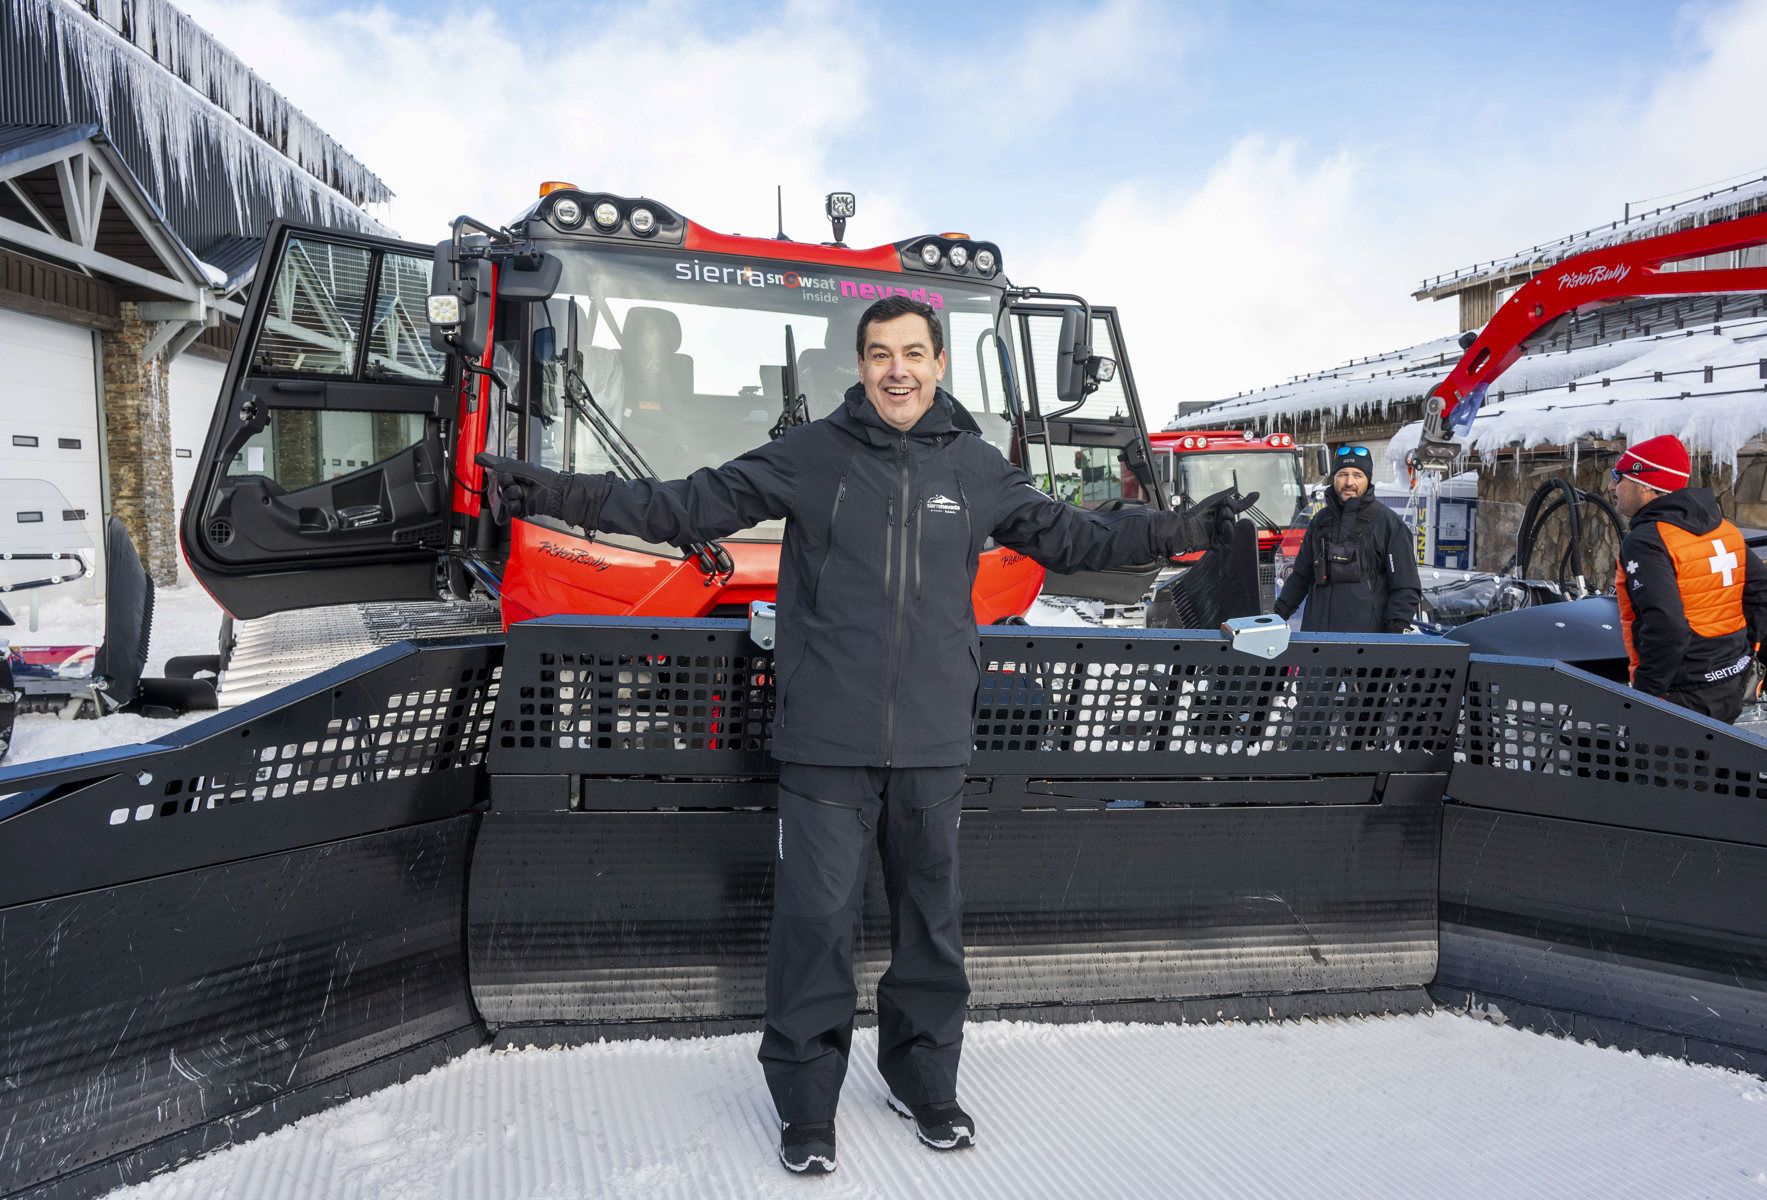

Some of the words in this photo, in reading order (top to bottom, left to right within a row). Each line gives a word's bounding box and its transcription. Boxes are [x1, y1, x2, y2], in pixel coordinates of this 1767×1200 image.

[675, 259, 765, 288] sierra
[766, 271, 836, 290] snowsat
[1558, 262, 1631, 291] PistenBully
[802, 289, 839, 304] inside
